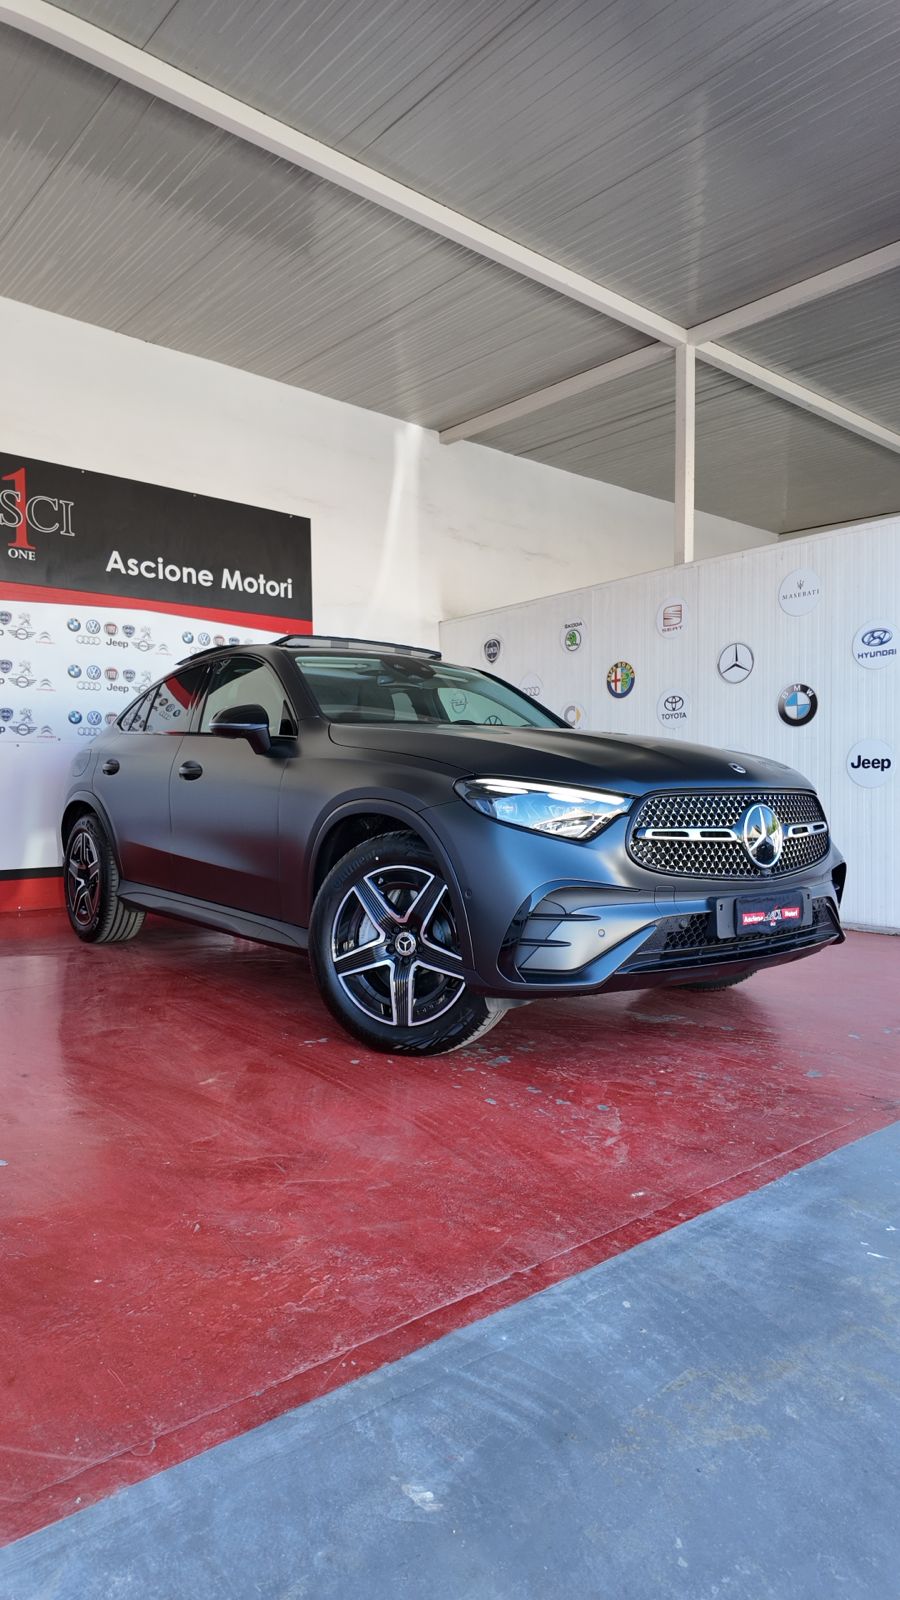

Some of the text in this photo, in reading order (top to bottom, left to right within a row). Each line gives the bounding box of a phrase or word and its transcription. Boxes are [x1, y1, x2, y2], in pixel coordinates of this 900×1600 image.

[8, 548, 36, 561] ONE
[106, 550, 292, 599] Ascione Motori
[781, 588, 820, 601] MASERATI
[662, 625, 683, 633] SEAT
[106, 638, 128, 648] Jeep
[857, 648, 897, 660] HYUNDAI
[106, 683, 129, 694] Jeep
[661, 712, 687, 721] TOYOTA
[851, 755, 891, 772] Jeep
